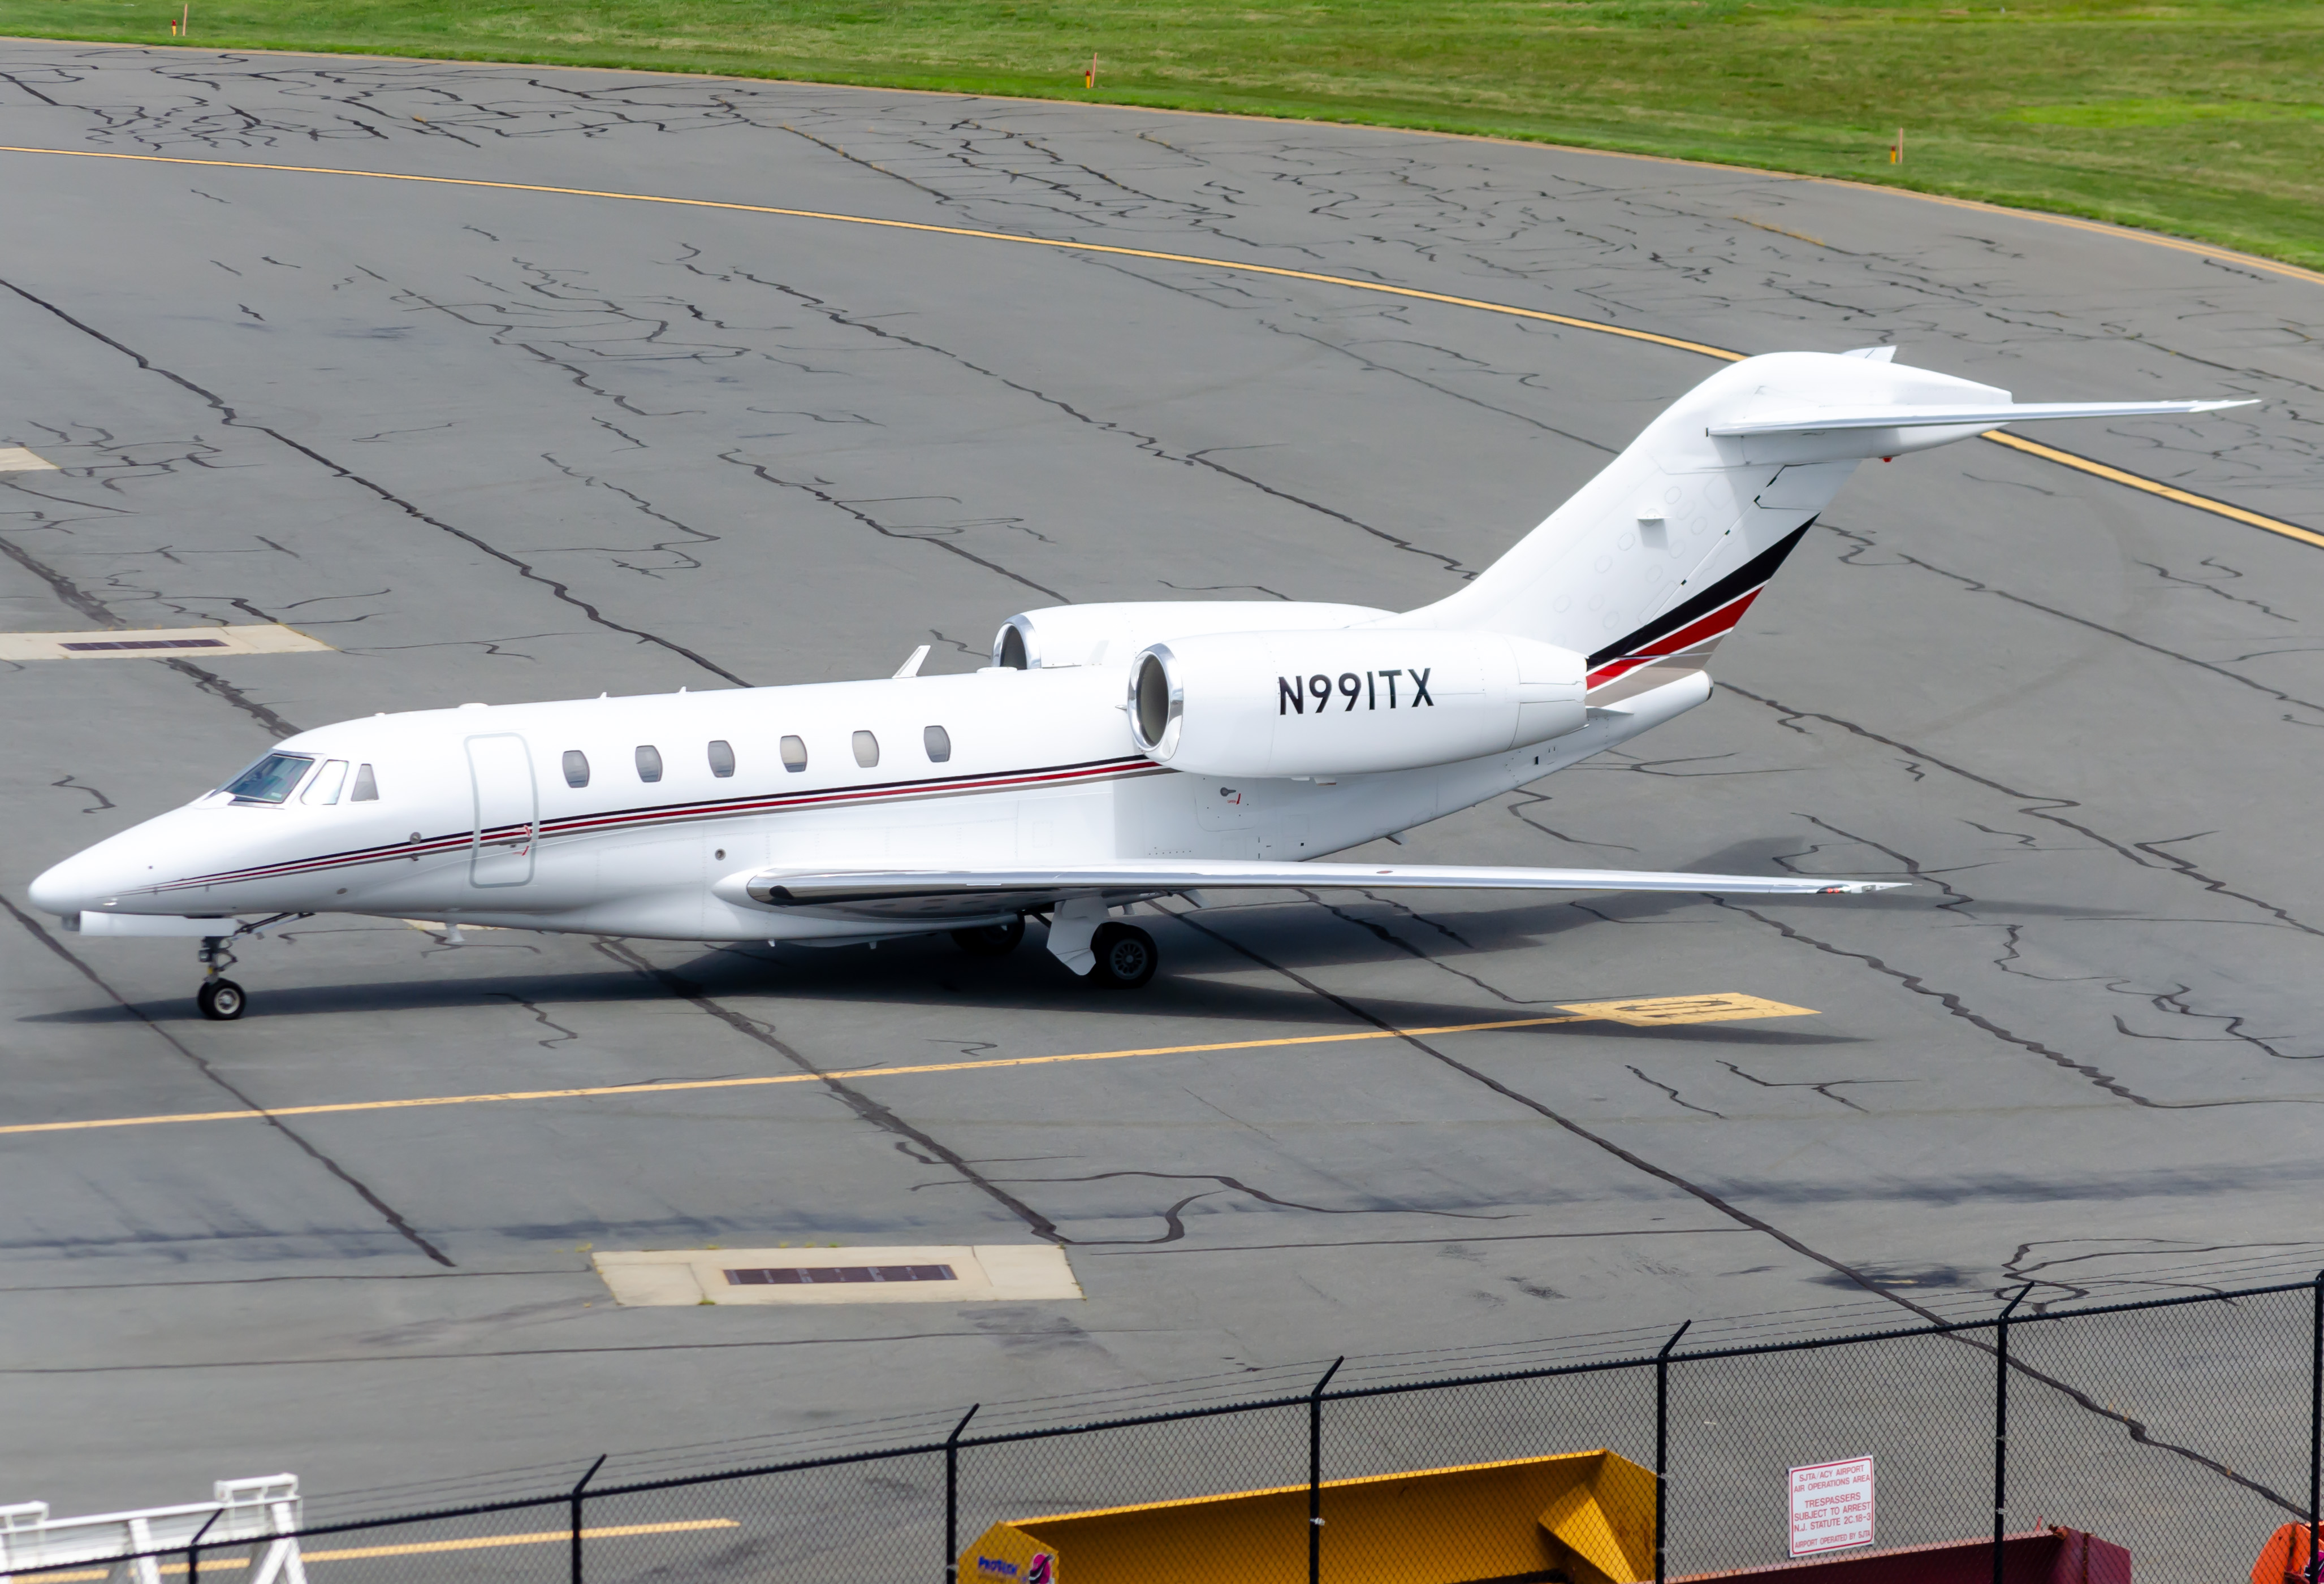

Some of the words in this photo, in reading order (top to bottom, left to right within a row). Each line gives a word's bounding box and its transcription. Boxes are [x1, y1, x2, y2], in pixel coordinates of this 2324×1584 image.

[1278, 668, 1435, 715] N991TX
[1799, 1470, 1833, 1482] SJTA/ACY
[1835, 1464, 1864, 1476] AIRPORT
[1808, 1477, 1850, 1491] OPERATIONS
[1852, 1474, 1871, 1483] AREA
[1805, 1492, 1861, 1508] TRESPASSERS
[1794, 1509, 1827, 1521] SUBJECT
[1830, 1507, 1840, 1516] TO
[1843, 1501, 1871, 1513] ARREST
[1794, 1523, 1807, 1532] N.J.
[1811, 1517, 1841, 1530] STATUTE
[1795, 1539, 1818, 1548] AIRPORT
[1820, 1534, 1847, 1545] OPERATED
[1858, 1530, 1871, 1539] SJTA
